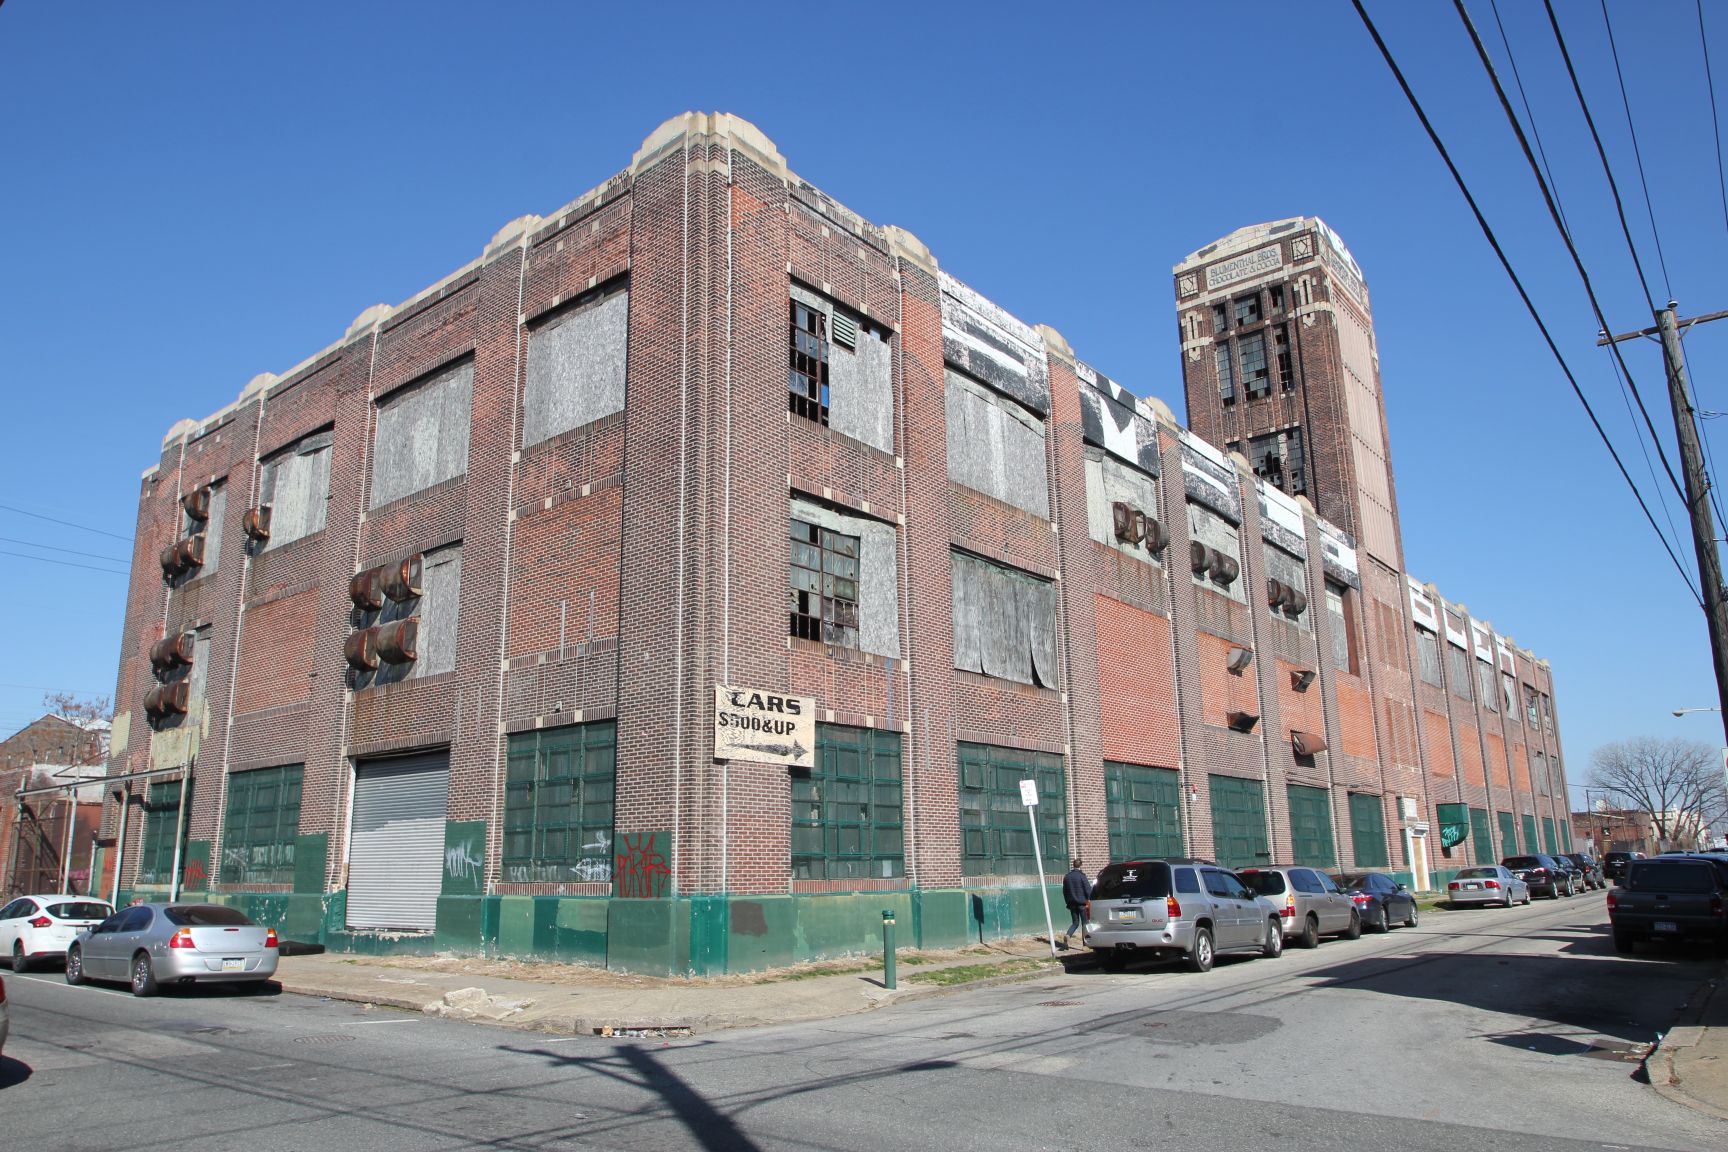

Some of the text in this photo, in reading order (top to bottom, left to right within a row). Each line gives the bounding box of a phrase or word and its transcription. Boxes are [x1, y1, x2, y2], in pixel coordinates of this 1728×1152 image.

[1208, 257, 1281, 287] CHOCOLATE & COCOA
[1210, 248, 1277, 278] BLUMENTHAL BROS.
[731, 691, 801, 716] CARS
